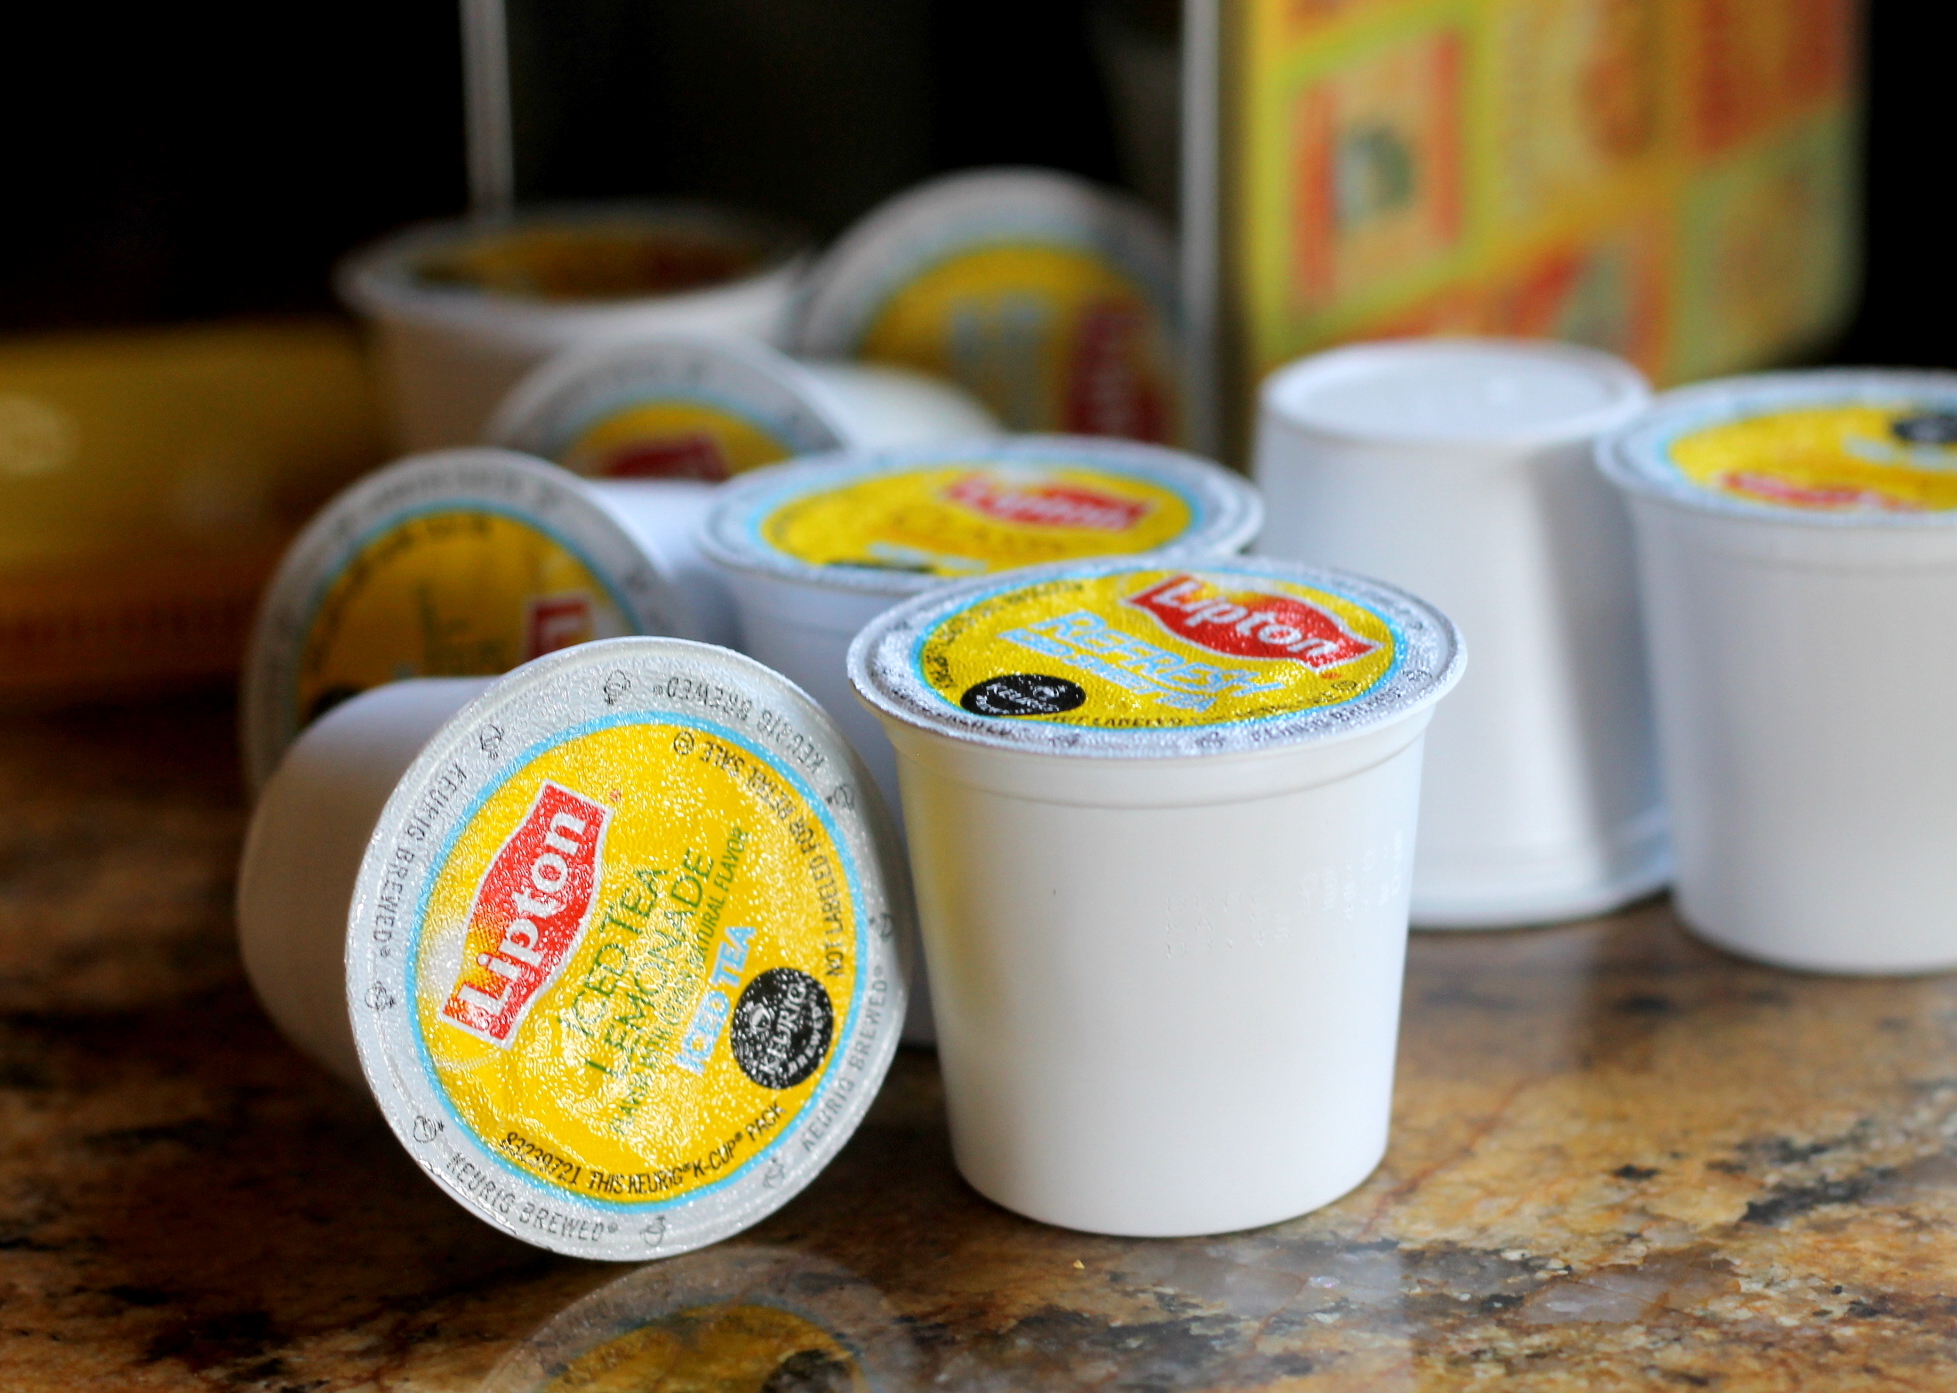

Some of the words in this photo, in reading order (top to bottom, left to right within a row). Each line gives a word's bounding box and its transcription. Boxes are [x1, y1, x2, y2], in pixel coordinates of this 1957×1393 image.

[1029, 608, 1286, 697] REFRESH
[1152, 580, 1340, 657] Lipton
[699, 740, 745, 777] SALE
[407, 762, 467, 841] KEURIG
[789, 814, 820, 854] FOR
[716, 827, 749, 900] FLAVOR
[810, 854, 844, 936] LABELED
[457, 811, 588, 1016] Lipton
[557, 942, 629, 1037] ICED
[600, 866, 668, 935] TEA
[585, 847, 714, 1079] LEMONADE
[825, 941, 844, 977] NOT
[674, 990, 730, 1074] ICED
[710, 926, 756, 987] TEA
[759, 982, 806, 1075] KEURIG
[588, 1171, 623, 1194] THIS
[745, 1101, 786, 1142] PACK
[801, 1077, 856, 1151] KEURIG
[446, 1152, 515, 1214] KEURIG
